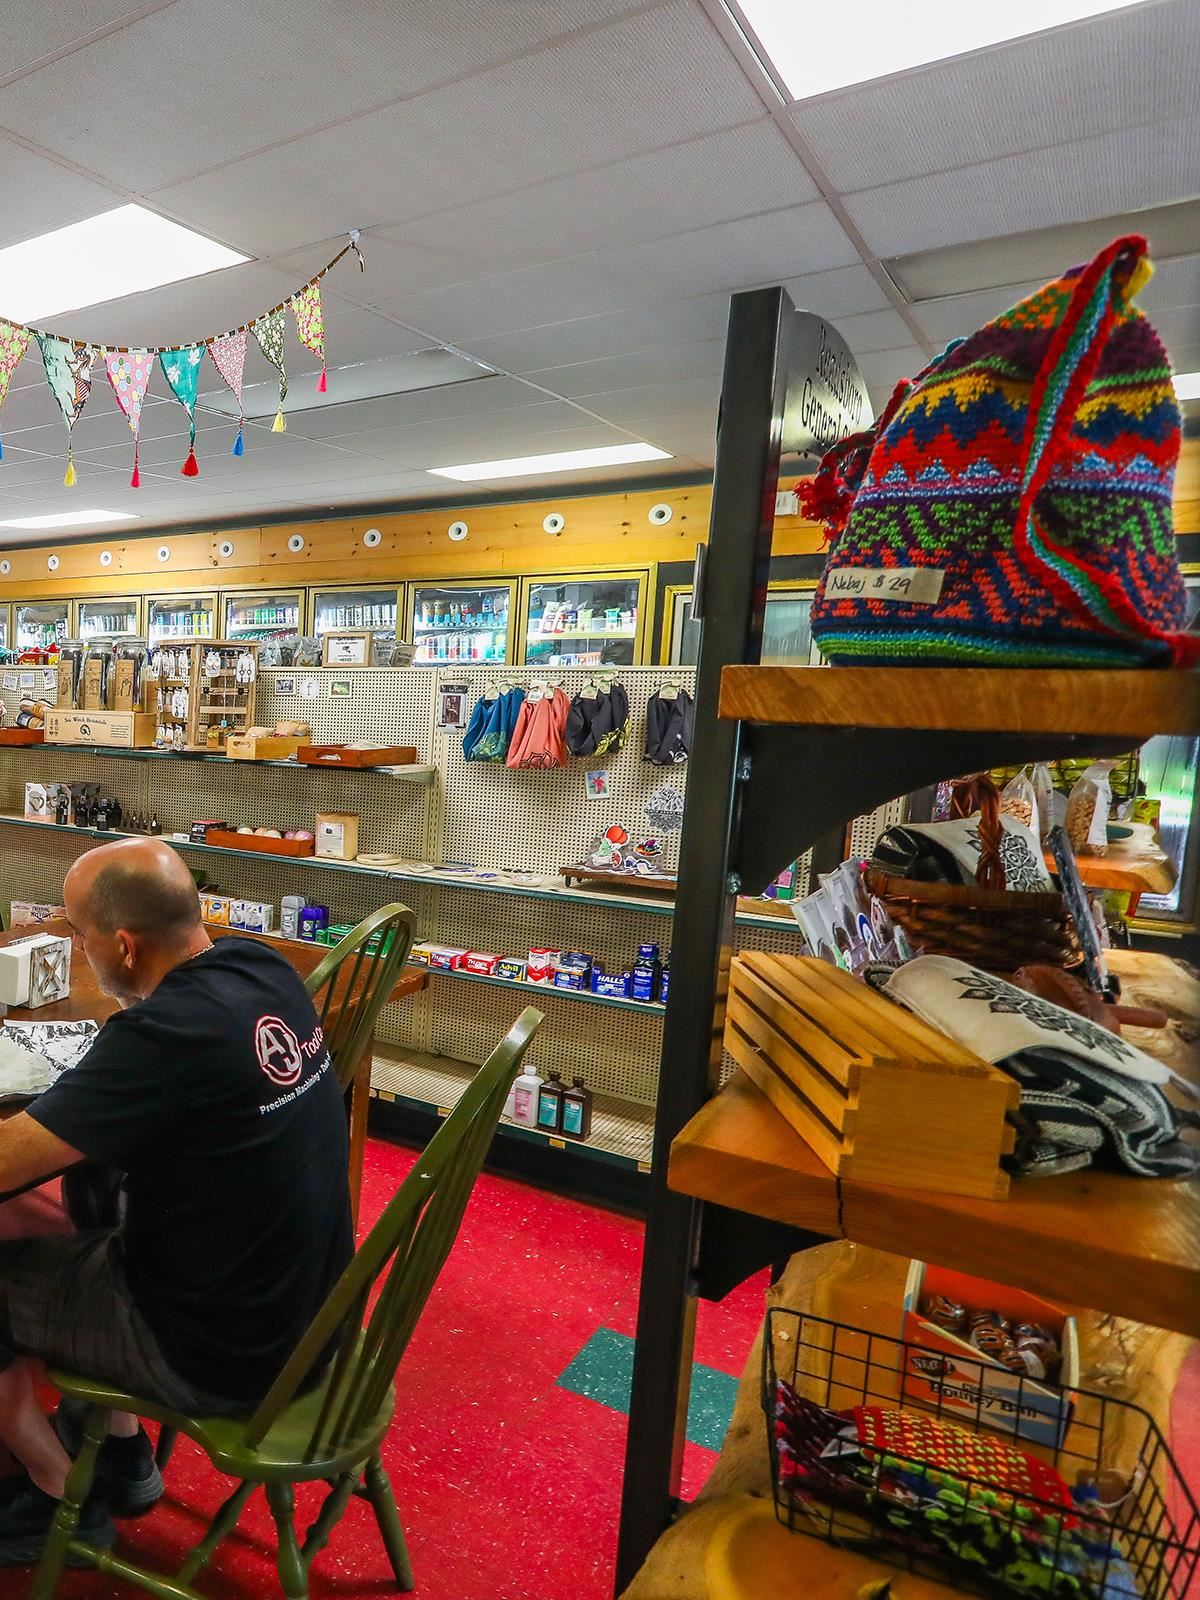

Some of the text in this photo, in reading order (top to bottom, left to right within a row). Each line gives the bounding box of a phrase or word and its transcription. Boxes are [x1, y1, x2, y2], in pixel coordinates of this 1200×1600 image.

[816, 323, 862, 425] Readsboro
[801, 376, 843, 443] General
[831, 575, 866, 594] Nebaj
[500, 963, 519, 972] Advil
[597, 975, 625, 984] HALLS
[259, 1093, 296, 1115] Precision
